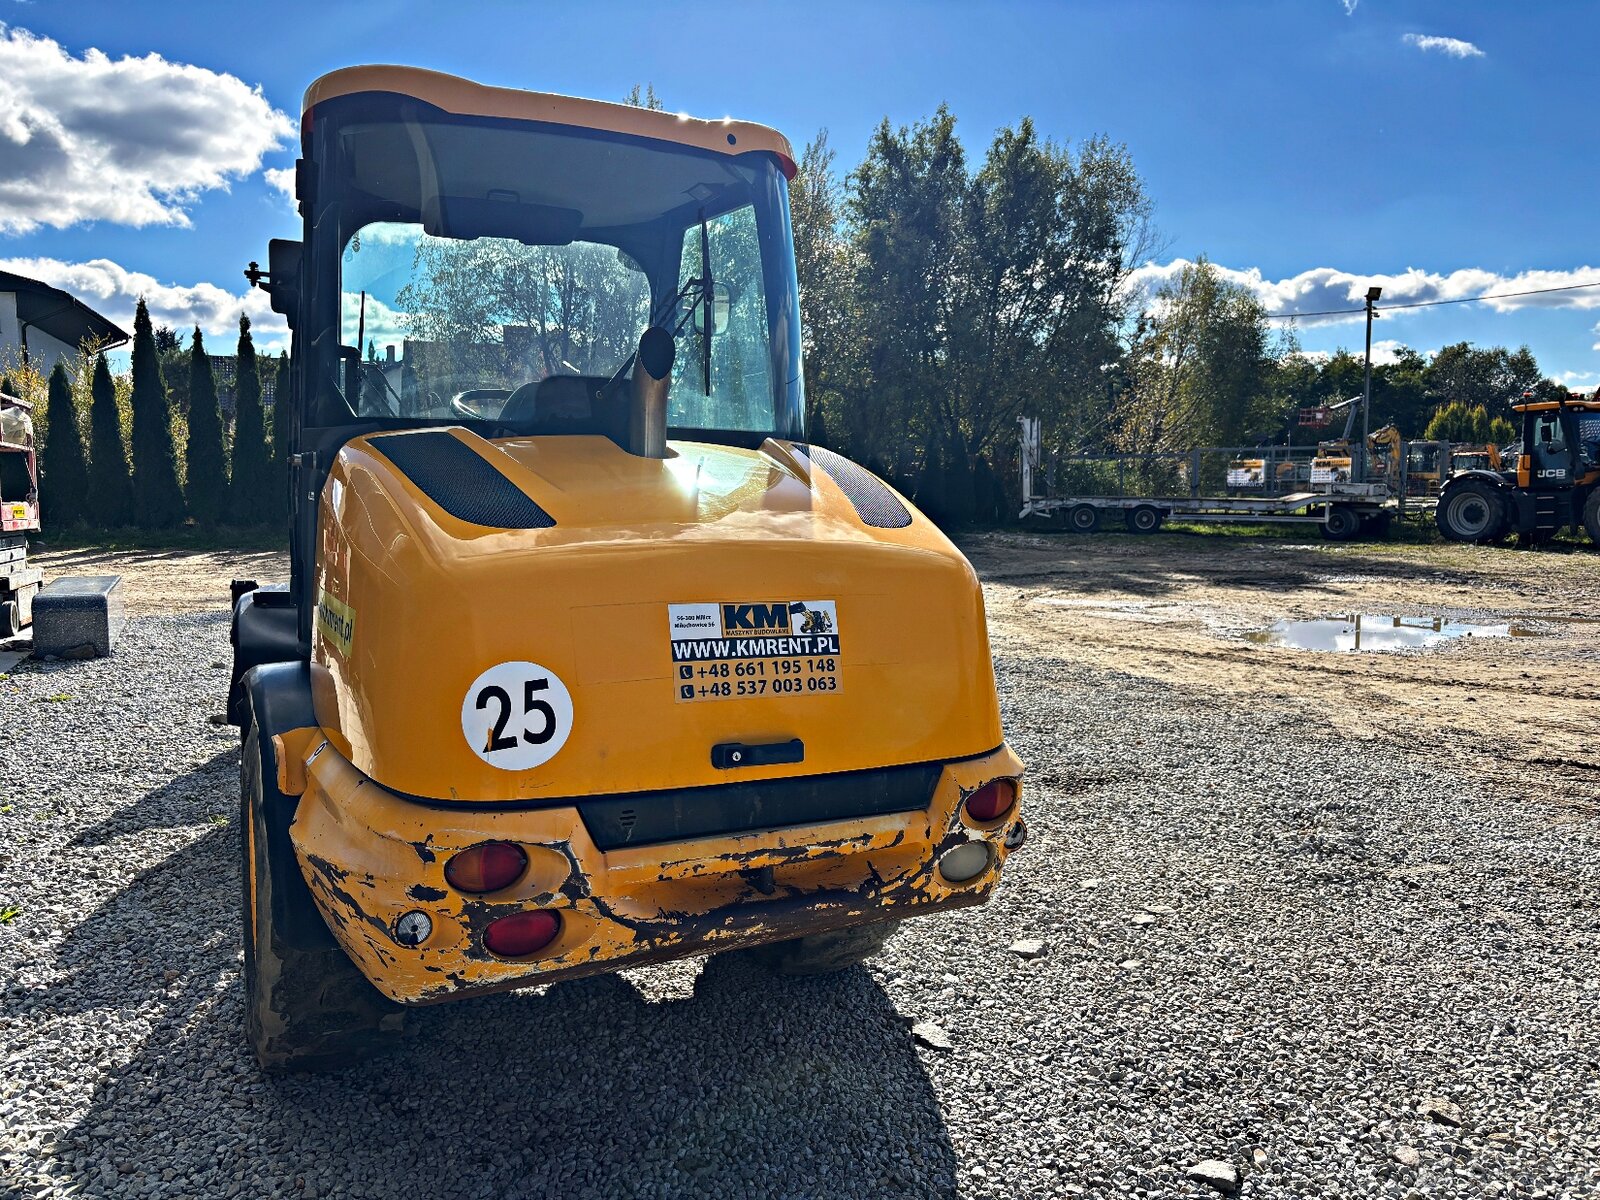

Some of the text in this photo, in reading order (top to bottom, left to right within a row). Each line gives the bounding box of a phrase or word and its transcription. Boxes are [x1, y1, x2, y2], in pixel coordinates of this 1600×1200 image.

[1537, 469, 1566, 478] JCB
[723, 604, 789, 630] KM
[672, 636, 839, 660] WWW.KMRENT.PL
[697, 658, 836, 679] +48 661 195 148
[698, 676, 837, 697] +48 537 003 063
[475, 677, 557, 754] 25
